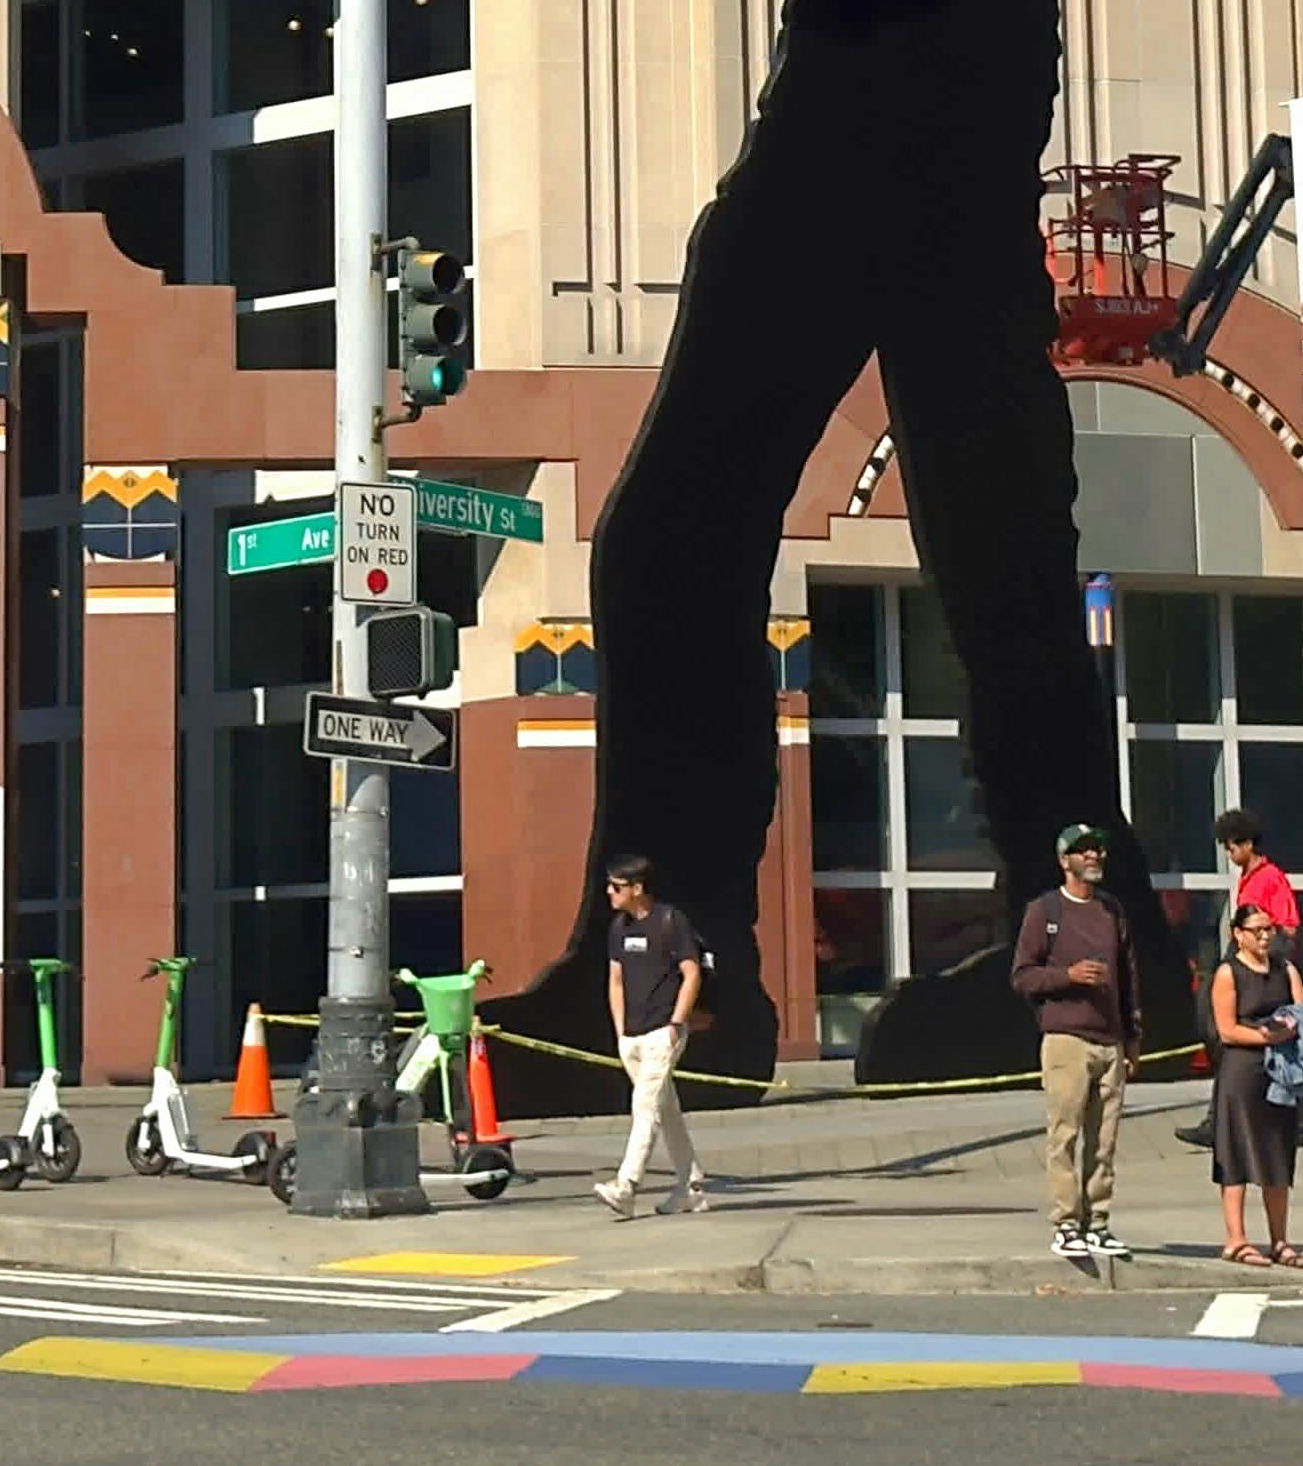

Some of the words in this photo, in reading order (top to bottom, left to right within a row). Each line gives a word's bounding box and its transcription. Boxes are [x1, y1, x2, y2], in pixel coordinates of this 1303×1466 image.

[359, 493, 395, 517] NO
[418, 484, 495, 533] iversity
[500, 507, 516, 532] St
[301, 527, 330, 551] Ave
[356, 521, 400, 542] TURN
[347, 545, 369, 564] ON
[378, 547, 408, 566] RED
[323, 713, 362, 740] ONE
[369, 719, 409, 744] WAY
